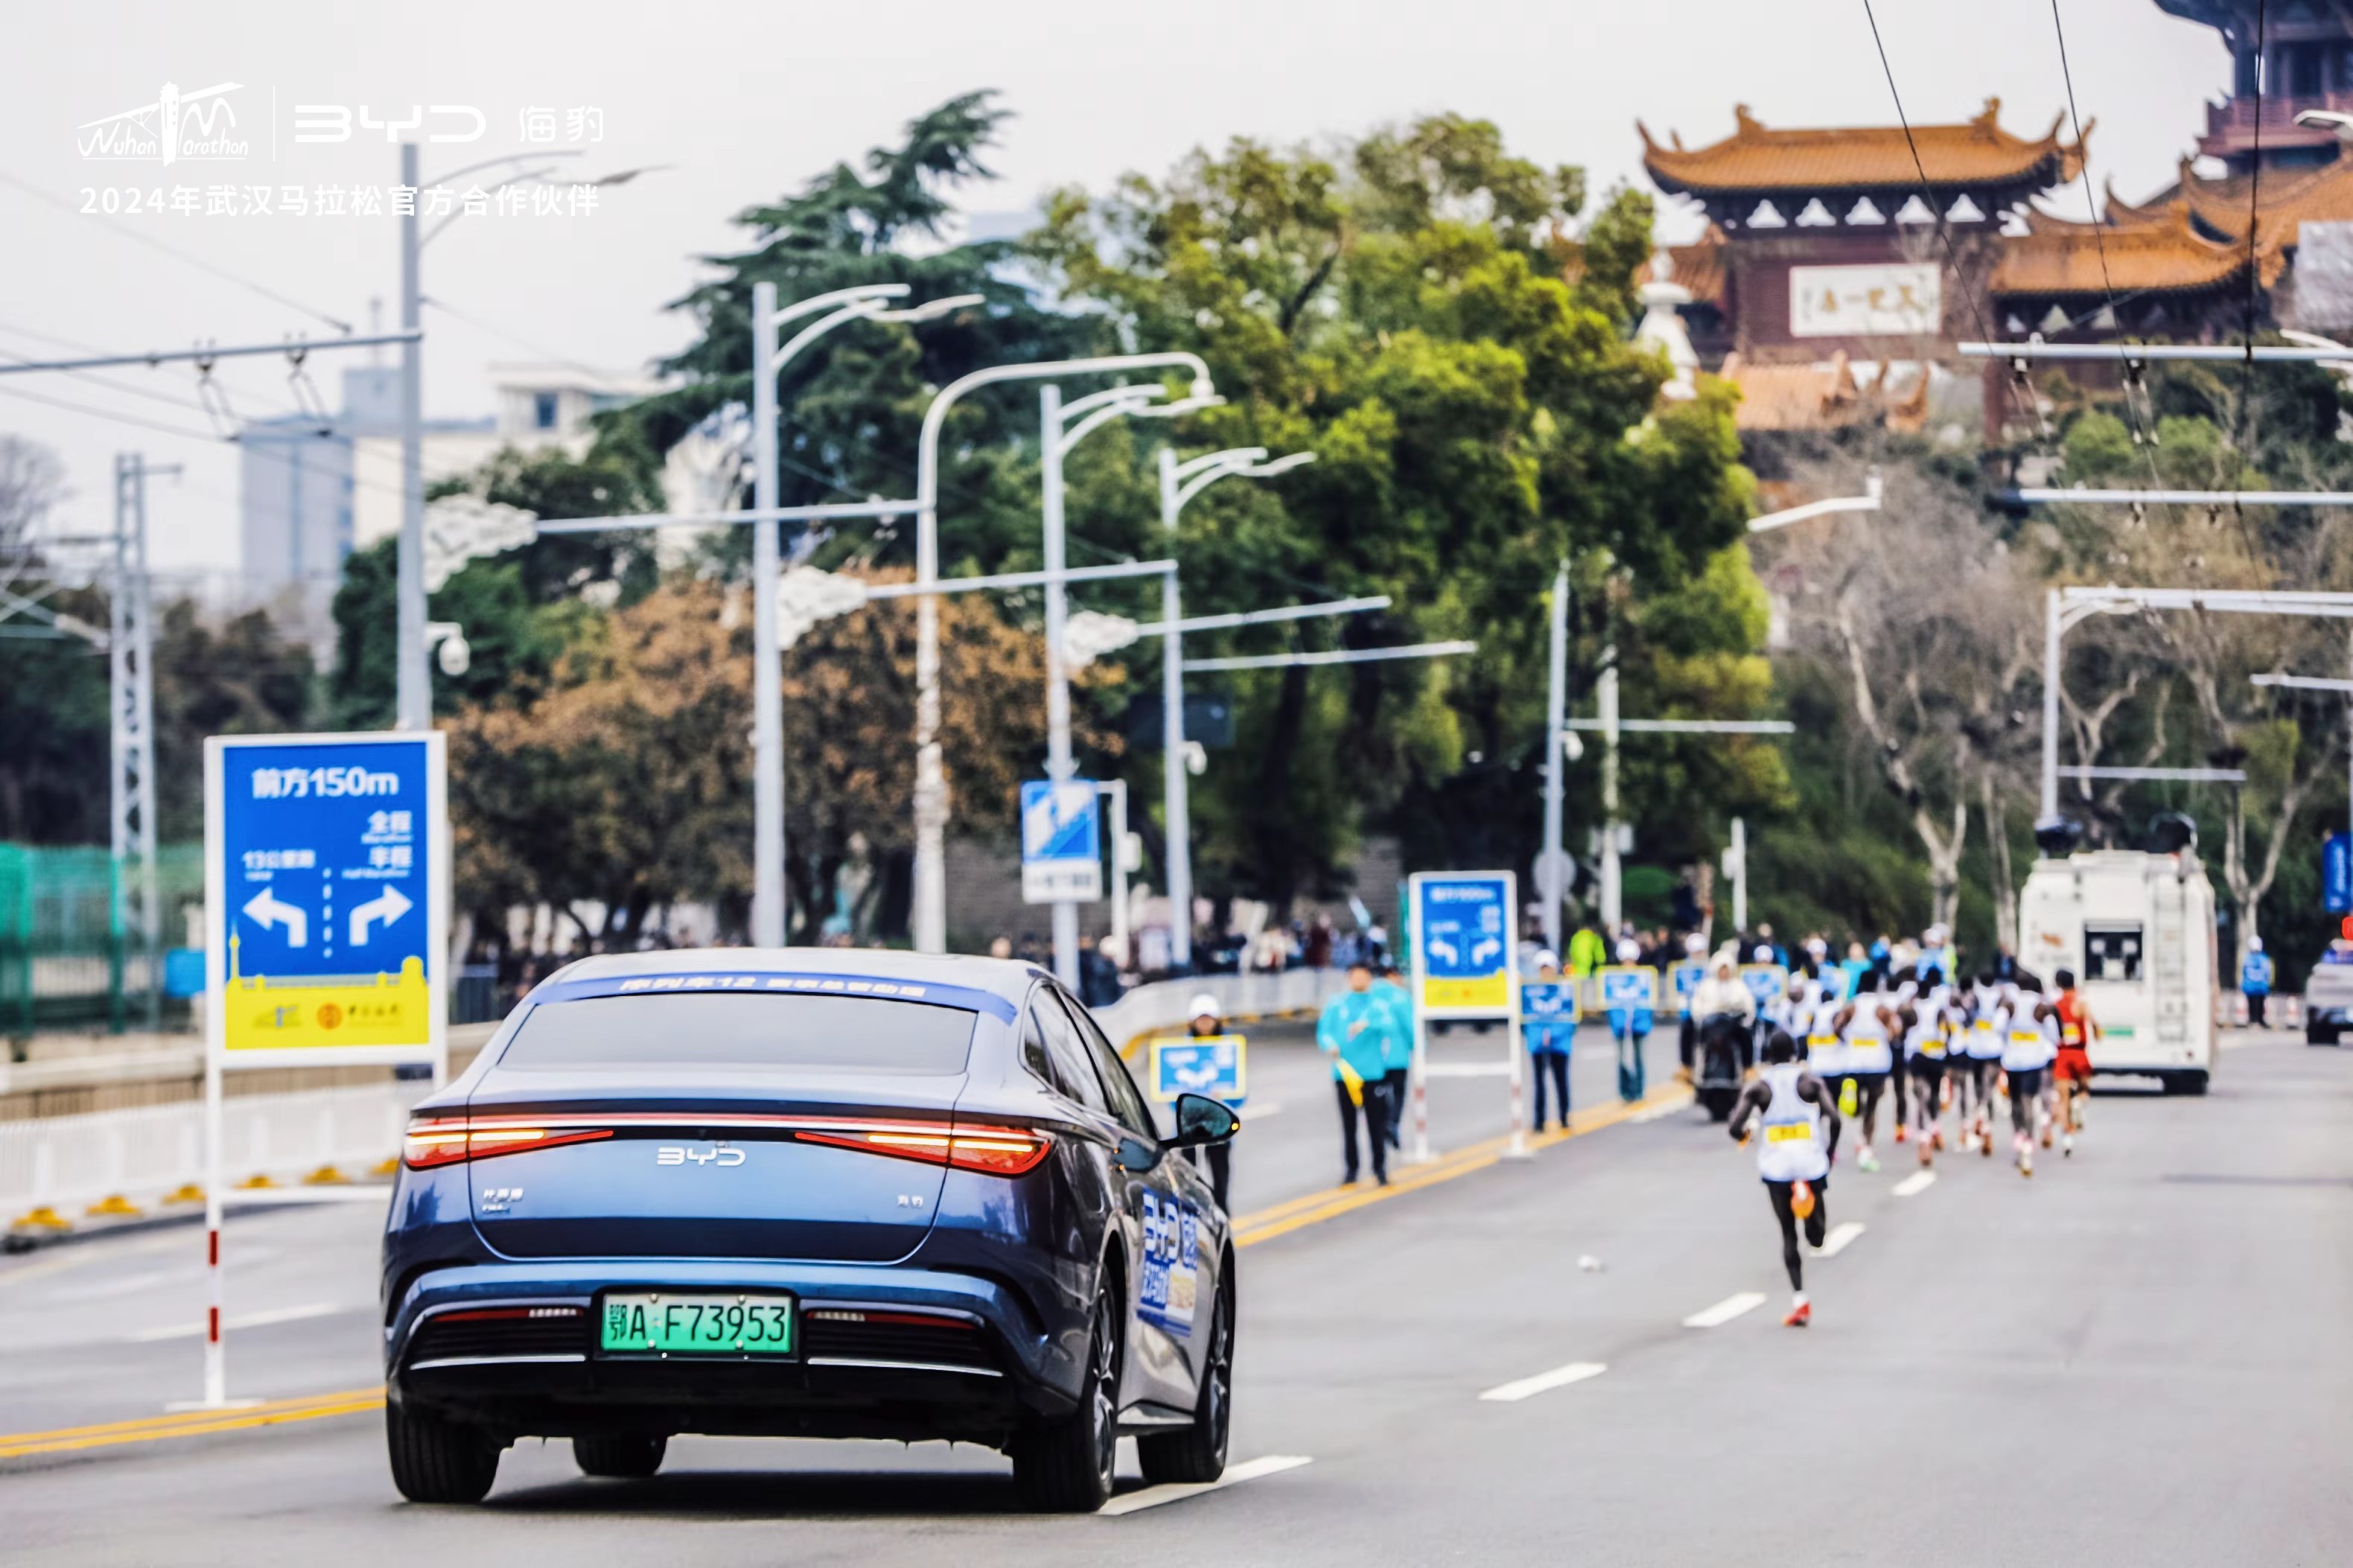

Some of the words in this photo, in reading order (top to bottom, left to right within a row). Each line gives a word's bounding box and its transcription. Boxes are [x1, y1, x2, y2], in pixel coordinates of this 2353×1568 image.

[252, 767, 399, 799] 前方150m
[657, 1147, 746, 1167] BYD
[608, 1304, 646, 1341] 鄂A
[665, 1304, 786, 1342] F73953
